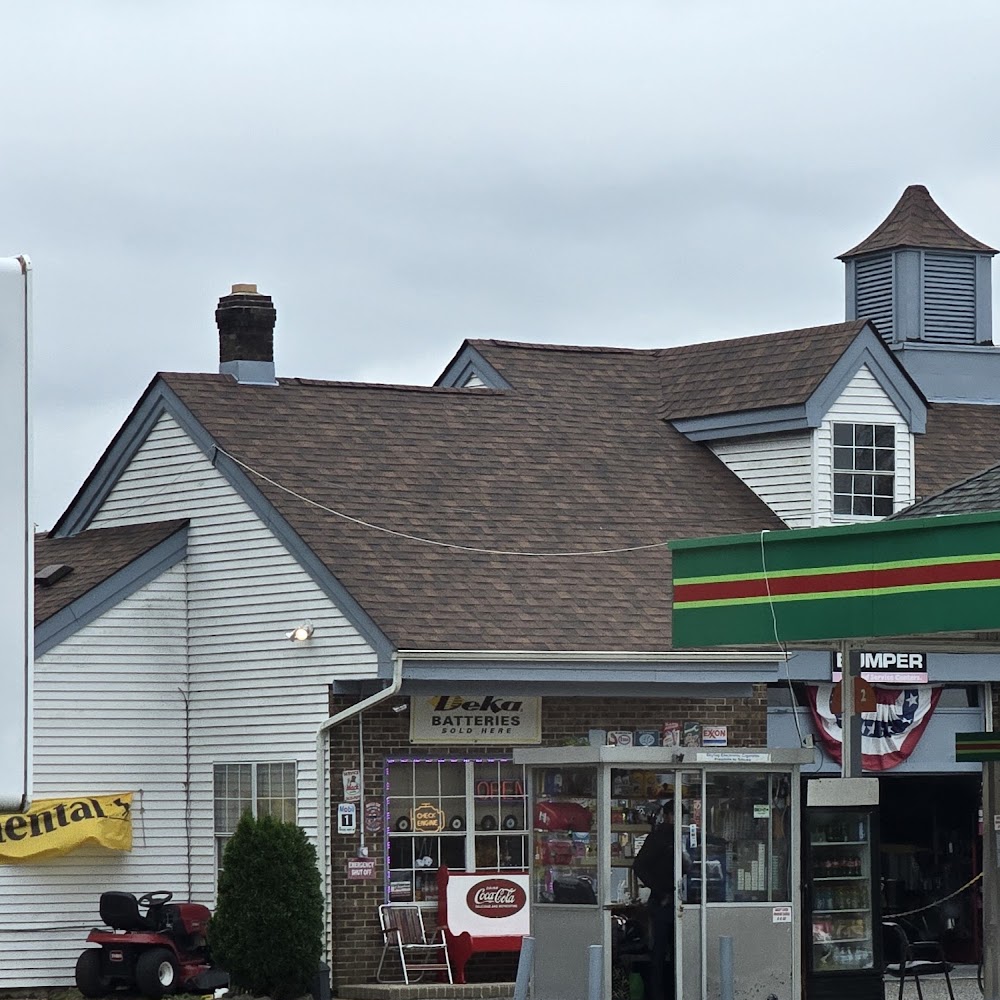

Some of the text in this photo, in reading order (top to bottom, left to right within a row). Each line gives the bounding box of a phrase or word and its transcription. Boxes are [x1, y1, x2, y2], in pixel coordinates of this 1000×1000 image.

[836, 653, 923, 669] MPER
[860, 688, 867, 702] 2
[434, 695, 523, 714] Deka
[431, 715, 521, 727] BATTERIES
[703, 729, 727, 739] EXXON
[476, 781, 525, 799] OPEN
[339, 805, 355, 813] Mobil
[416, 811, 437, 819] CHECK
[348, 861, 375, 869] EMERGENCY
[351, 868, 372, 876] SHUT OFF
[474, 888, 517, 905] Coca-Cola
